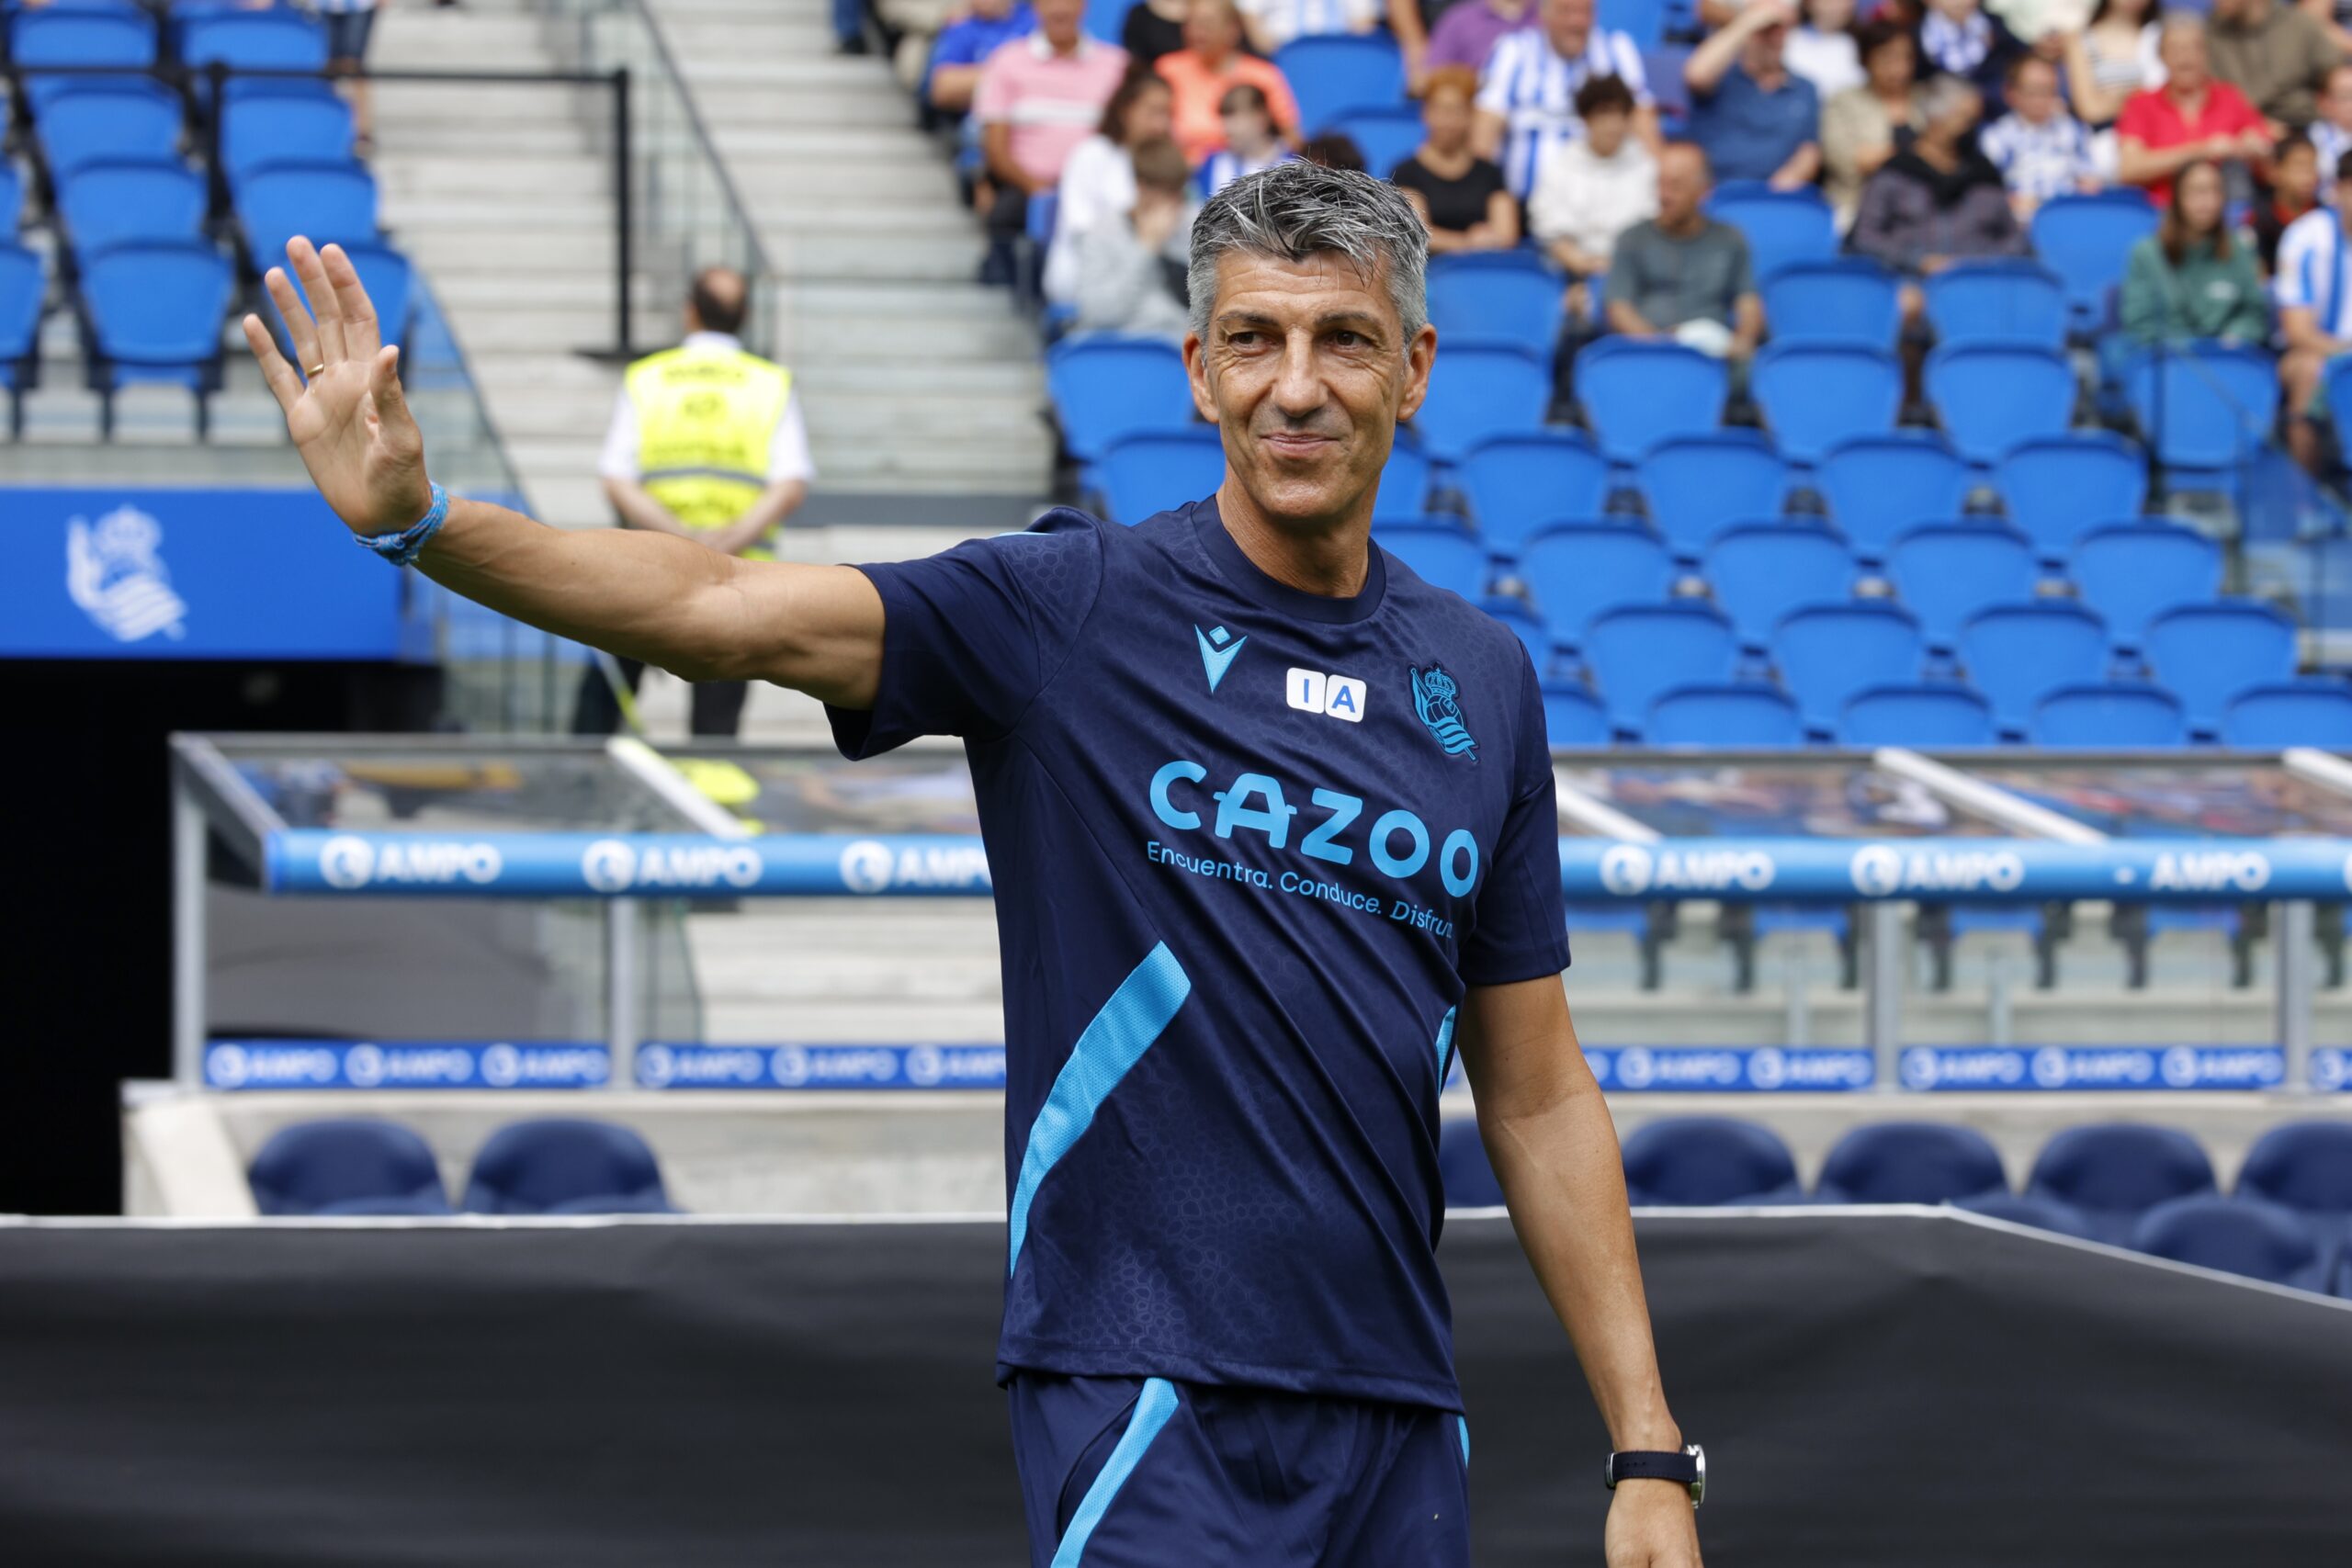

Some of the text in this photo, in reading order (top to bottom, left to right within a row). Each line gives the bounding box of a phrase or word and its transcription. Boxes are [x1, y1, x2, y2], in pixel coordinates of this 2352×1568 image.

[1149, 761, 1478, 897] CAZOO
[378, 842, 503, 885] AMPO
[639, 846, 763, 888] AMPO
[1147, 840, 1273, 890] Encuentra.
[1280, 872, 1382, 916] Conduce.
[1657, 851, 2272, 893] AMPO AMPO AMPO
